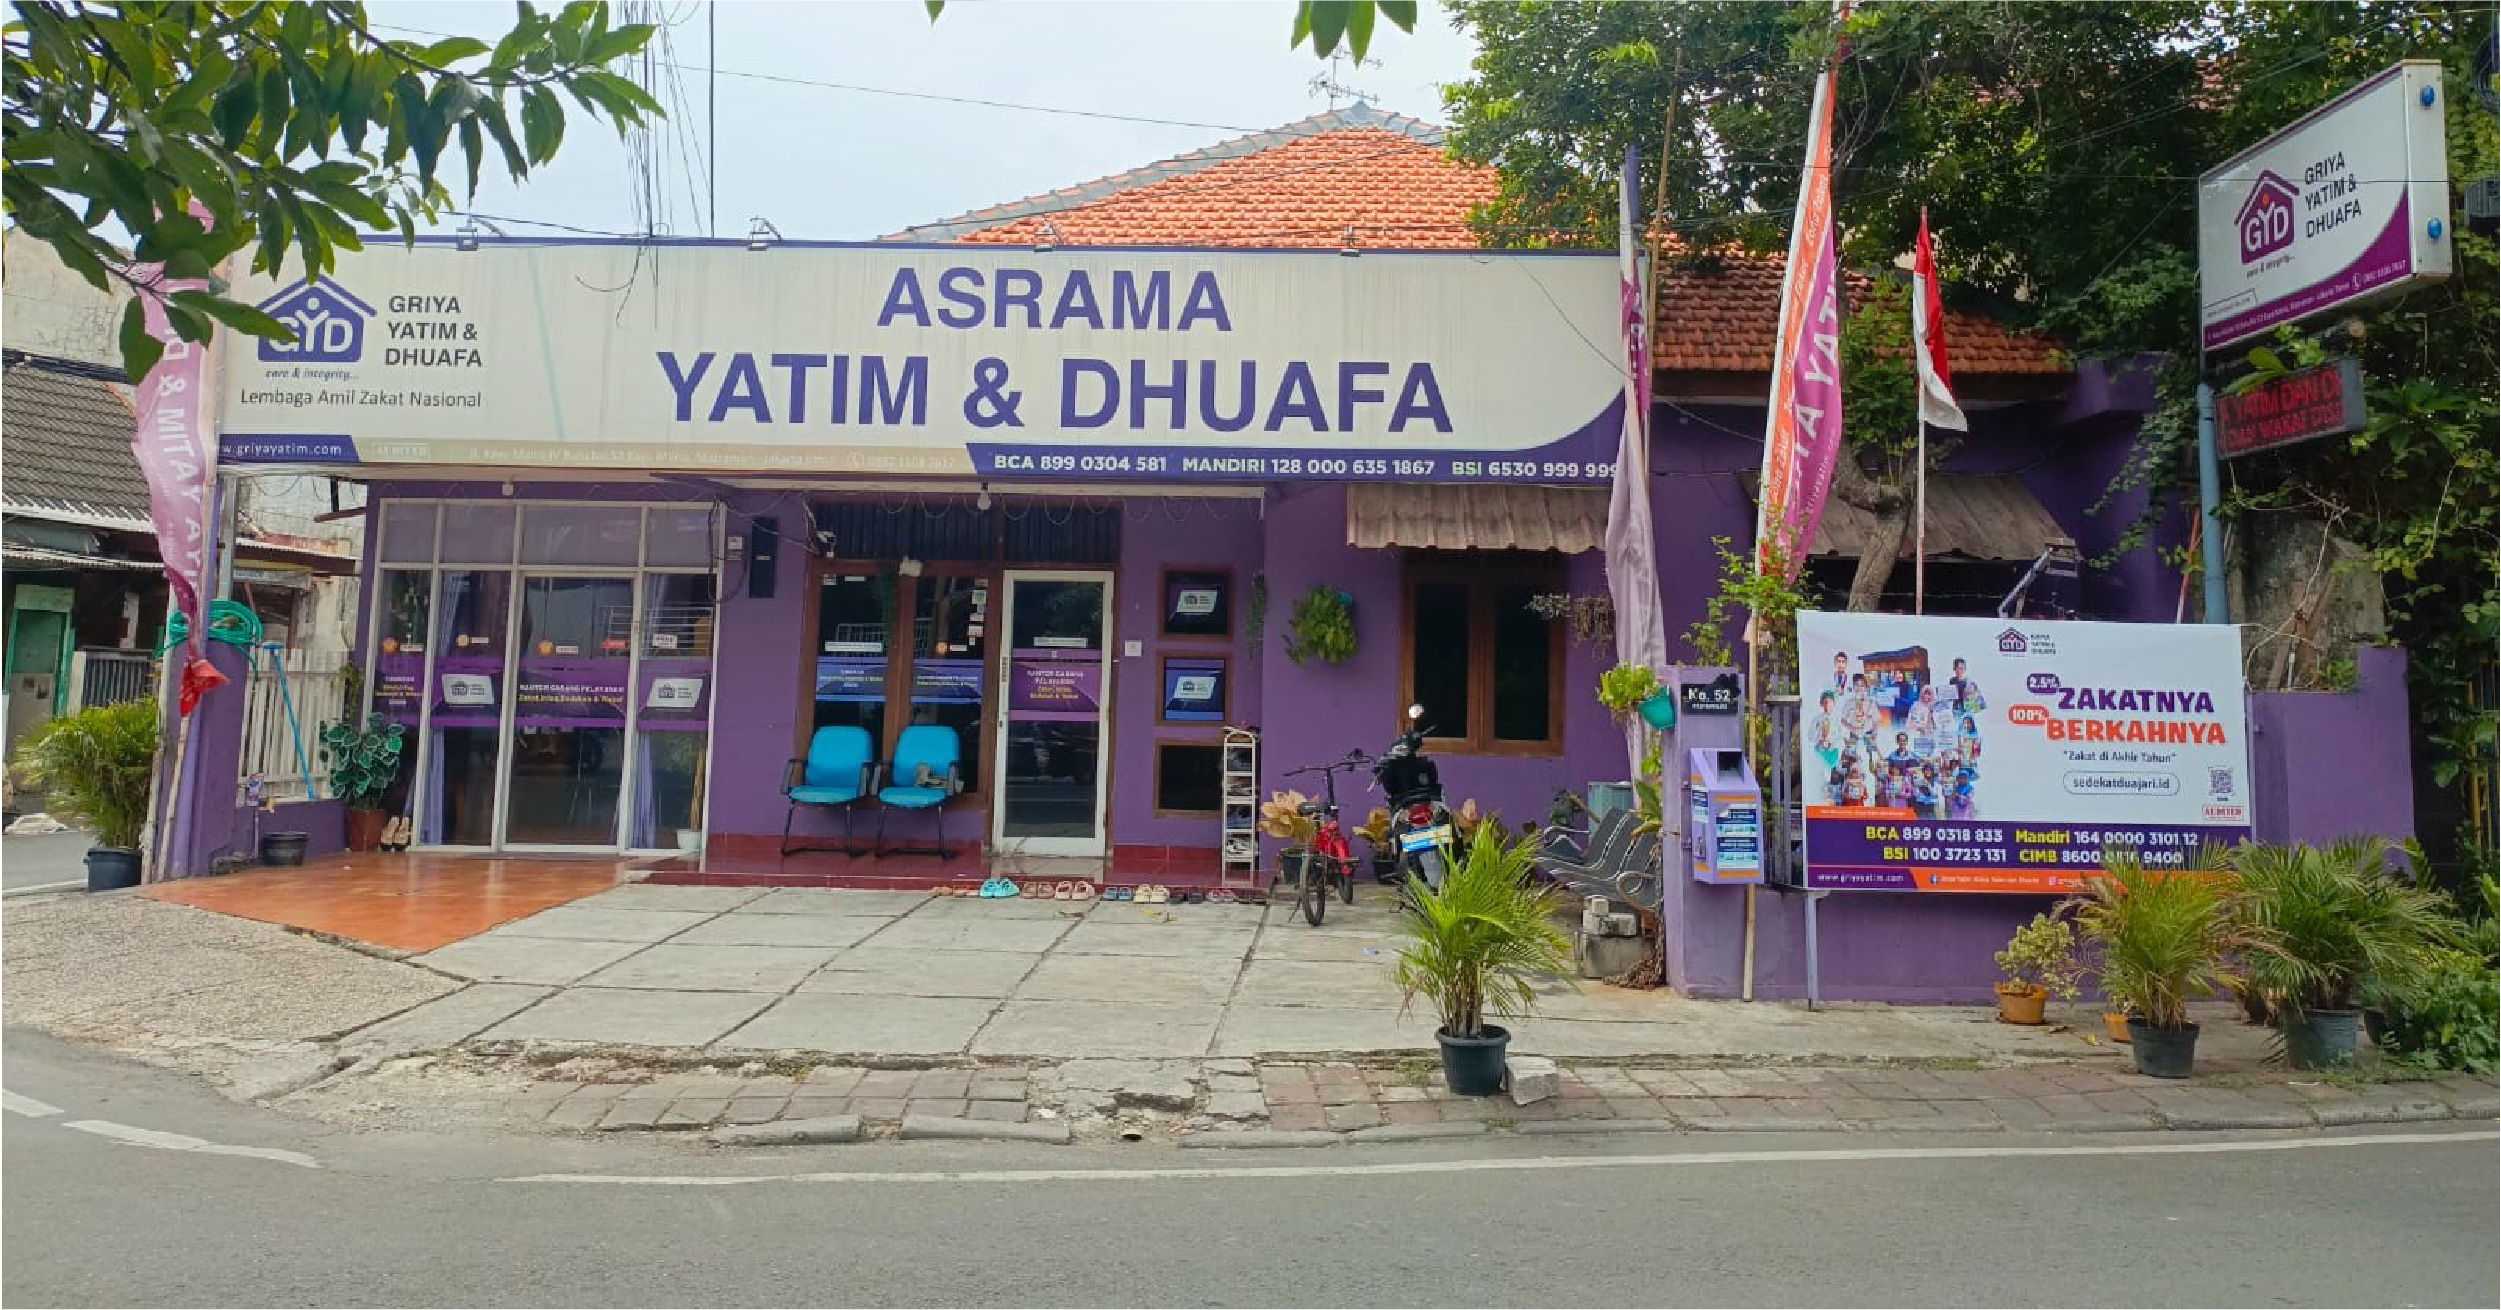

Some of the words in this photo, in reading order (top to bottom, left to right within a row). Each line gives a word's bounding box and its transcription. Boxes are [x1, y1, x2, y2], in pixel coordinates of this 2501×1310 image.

[2304, 151, 2346, 185] GRIYA
[2305, 177, 2345, 210] YATIM
[2349, 173, 2357, 193] &
[2245, 201, 2289, 252] GYD
[2305, 199, 2361, 238] DHUAFA
[388, 295, 462, 314] GRIYA
[876, 266, 1232, 332] ASRAMA
[387, 322, 458, 341] YATIM
[462, 322, 478, 341] &
[384, 347, 482, 367] DHUAFA
[241, 388, 315, 408] Lembaga
[319, 389, 355, 405] Amil
[358, 389, 404, 405] Zakat
[410, 390, 482, 408] Nasional
[655, 351, 929, 425] YATIM
[963, 356, 1025, 428] &
[1060, 358, 1453, 433] DHUAFA
[994, 455, 1035, 469] BCA
[1040, 455, 1076, 470] 899
[1080, 456, 1131, 471] 0304
[1135, 456, 1166, 472] 581
[1183, 458, 1265, 473] MANDIRI
[1271, 458, 1301, 474] 128
[1307, 459, 1347, 474] 000
[1352, 459, 1387, 475] 635
[1391, 460, 1436, 475] 1867
[1452, 461, 1482, 475] BSI
[1488, 461, 1537, 476] 6530
[1543, 462, 1579, 477] 999
[1713, 688, 1731, 702] 52
[2058, 687, 2214, 713] ZAKATNYA
[2011, 708, 2046, 721] 100%
[2047, 719, 2227, 744] BERKAHNYA
[1865, 825, 1900, 840] BCA
[1902, 827, 1932, 841] 899
[1936, 828, 1971, 842] 0318
[2015, 828, 2070, 844] Mandiri
[2073, 831, 2100, 844] 164
[2104, 831, 2145, 846] 0000
[2149, 831, 2179, 846] 3101
[2182, 832, 2198, 846] 12
[1883, 847, 1909, 860] BSI
[1912, 847, 1941, 861] 100
[1944, 848, 1981, 862] 3723
[1984, 848, 2007, 862] 131
[2019, 849, 2058, 863] CIMB
[2062, 850, 2101, 863] 8600
[2143, 851, 2183, 864] 9400
